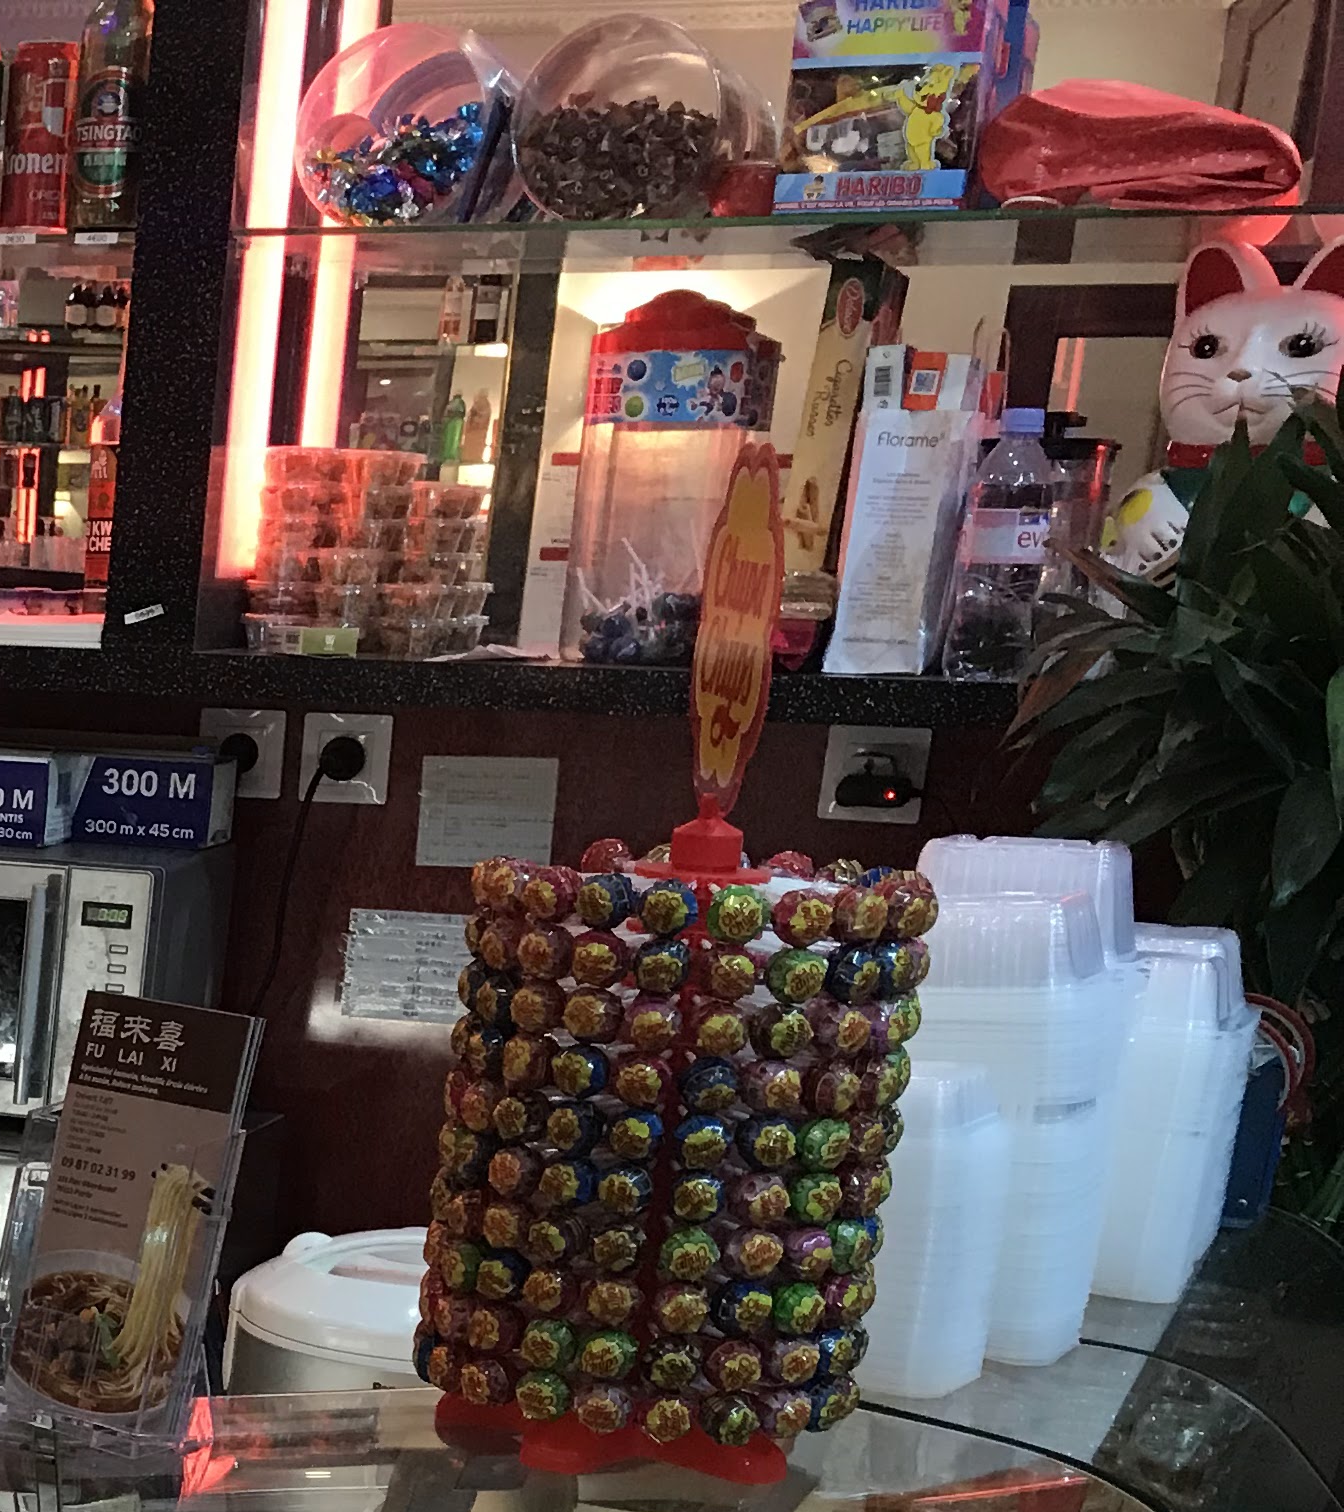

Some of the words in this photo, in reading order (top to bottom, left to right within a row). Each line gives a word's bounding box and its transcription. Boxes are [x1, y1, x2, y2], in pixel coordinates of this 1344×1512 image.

[76, 125, 143, 142] TSINGTAO
[835, 174, 923, 198] HARIBO
[102, 768, 158, 797] 300
[169, 772, 196, 799] M
[11, 789, 35, 811] M
[15, 831, 33, 841] cm
[84, 819, 117, 835] 300
[119, 824, 133, 836] m
[136, 825, 145, 837] x
[149, 823, 170, 838] 45
[172, 828, 194, 839] cm
[86, 1042, 105, 1058] FU
[118, 1048, 144, 1066] LAI
[160, 1055, 178, 1073] XI
[61, 1156, 74, 1168] 09
[90, 1162, 104, 1175] 02
[105, 1165, 119, 1178] 31
[121, 1168, 136, 1181] 99
